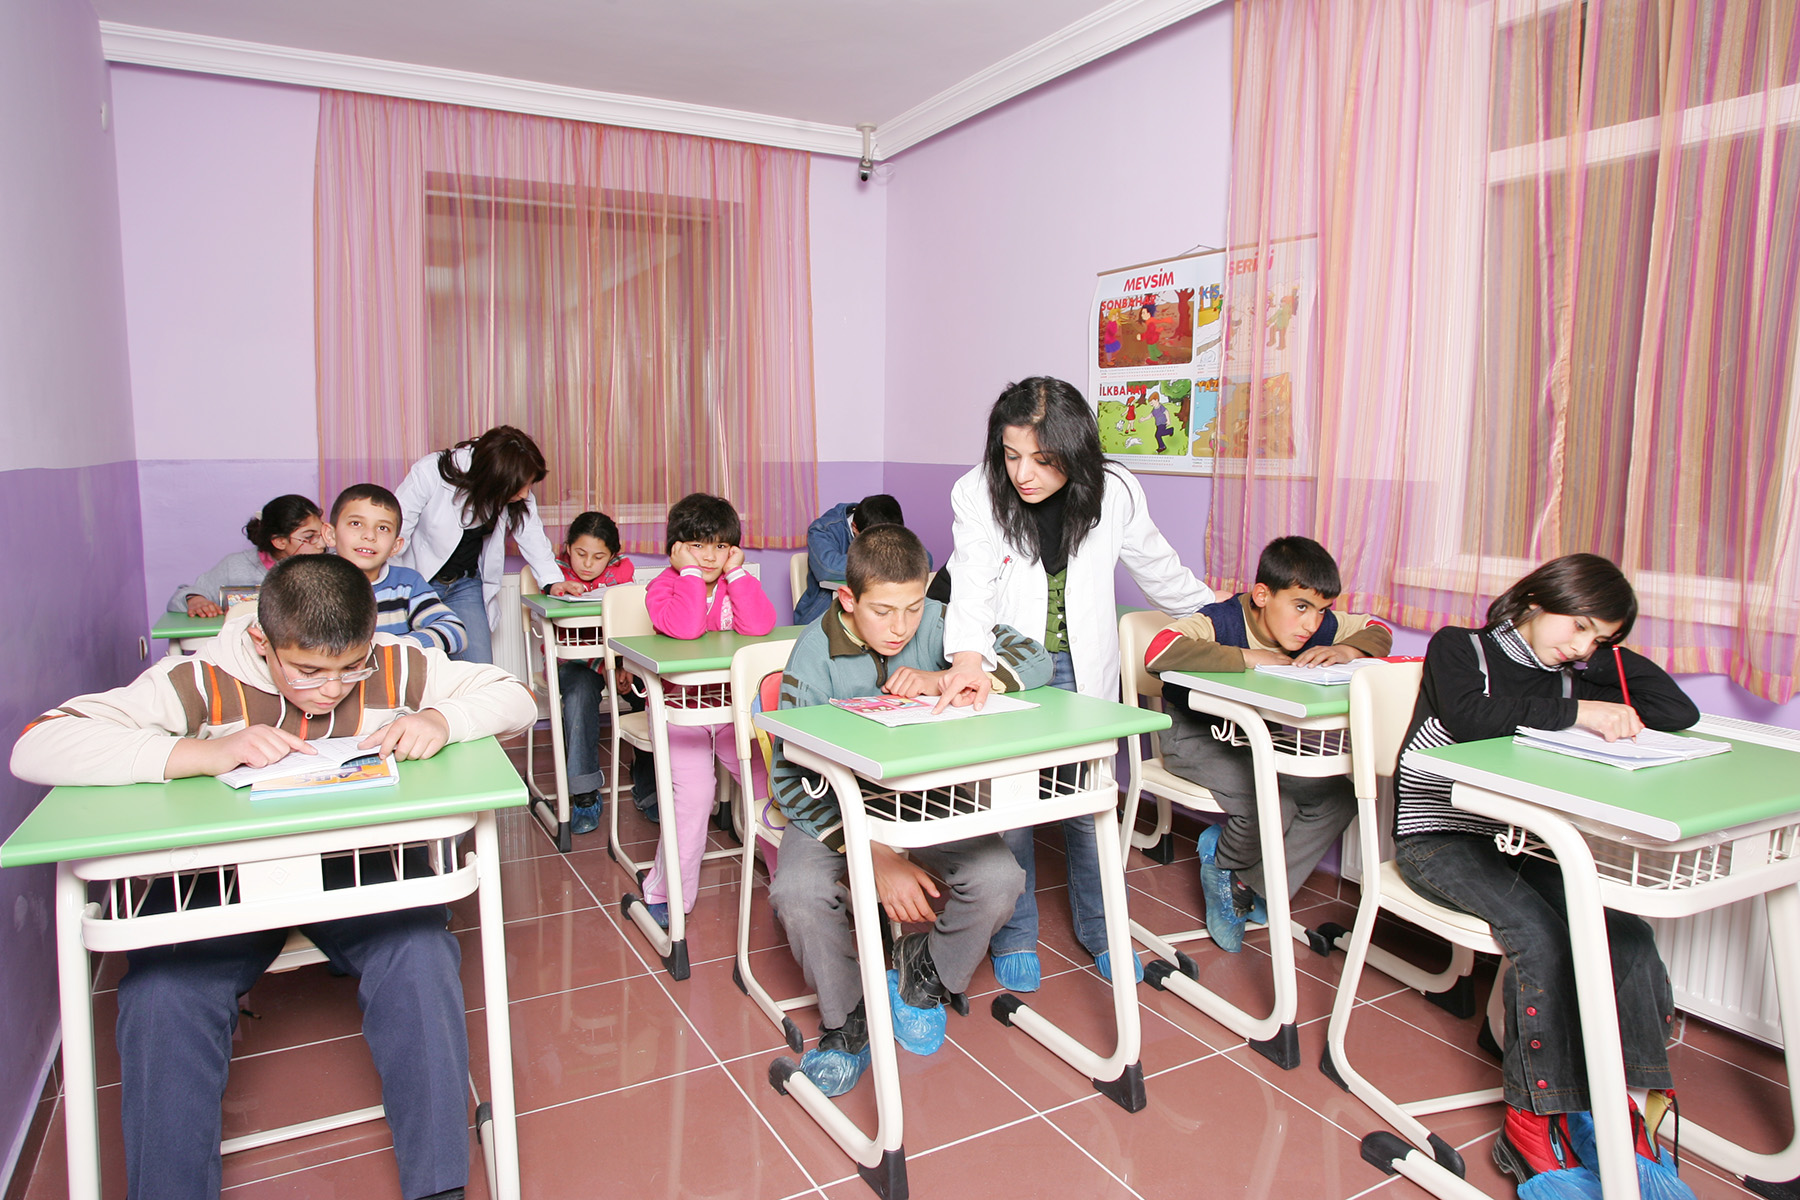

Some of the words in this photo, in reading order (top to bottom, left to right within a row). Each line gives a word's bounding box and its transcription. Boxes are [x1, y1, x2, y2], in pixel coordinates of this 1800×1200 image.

[1123, 268, 1174, 292] MEVSİM
[1101, 294, 1156, 311] SONBAHAR
[1099, 382, 1147, 397] İLKBAHAR
[1198, 379, 1219, 393] YAZ
